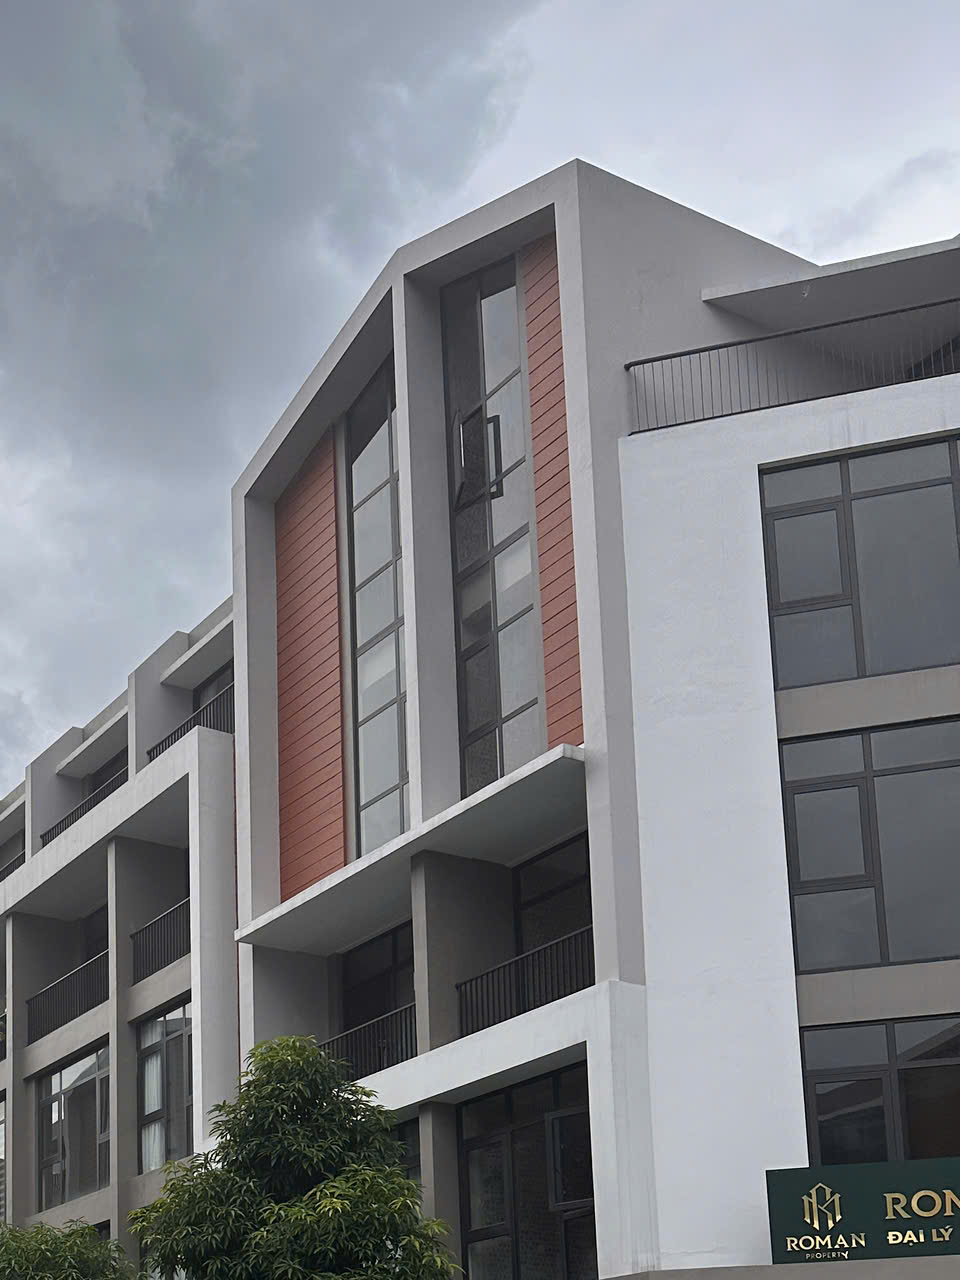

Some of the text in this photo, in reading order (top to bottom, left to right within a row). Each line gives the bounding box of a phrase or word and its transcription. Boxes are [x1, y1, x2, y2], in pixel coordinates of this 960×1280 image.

[785, 1232, 866, 1251] ROMAN
[886, 1225, 954, 1246] ĐẠI LÝ
[805, 1250, 849, 1260] PROPERTY
